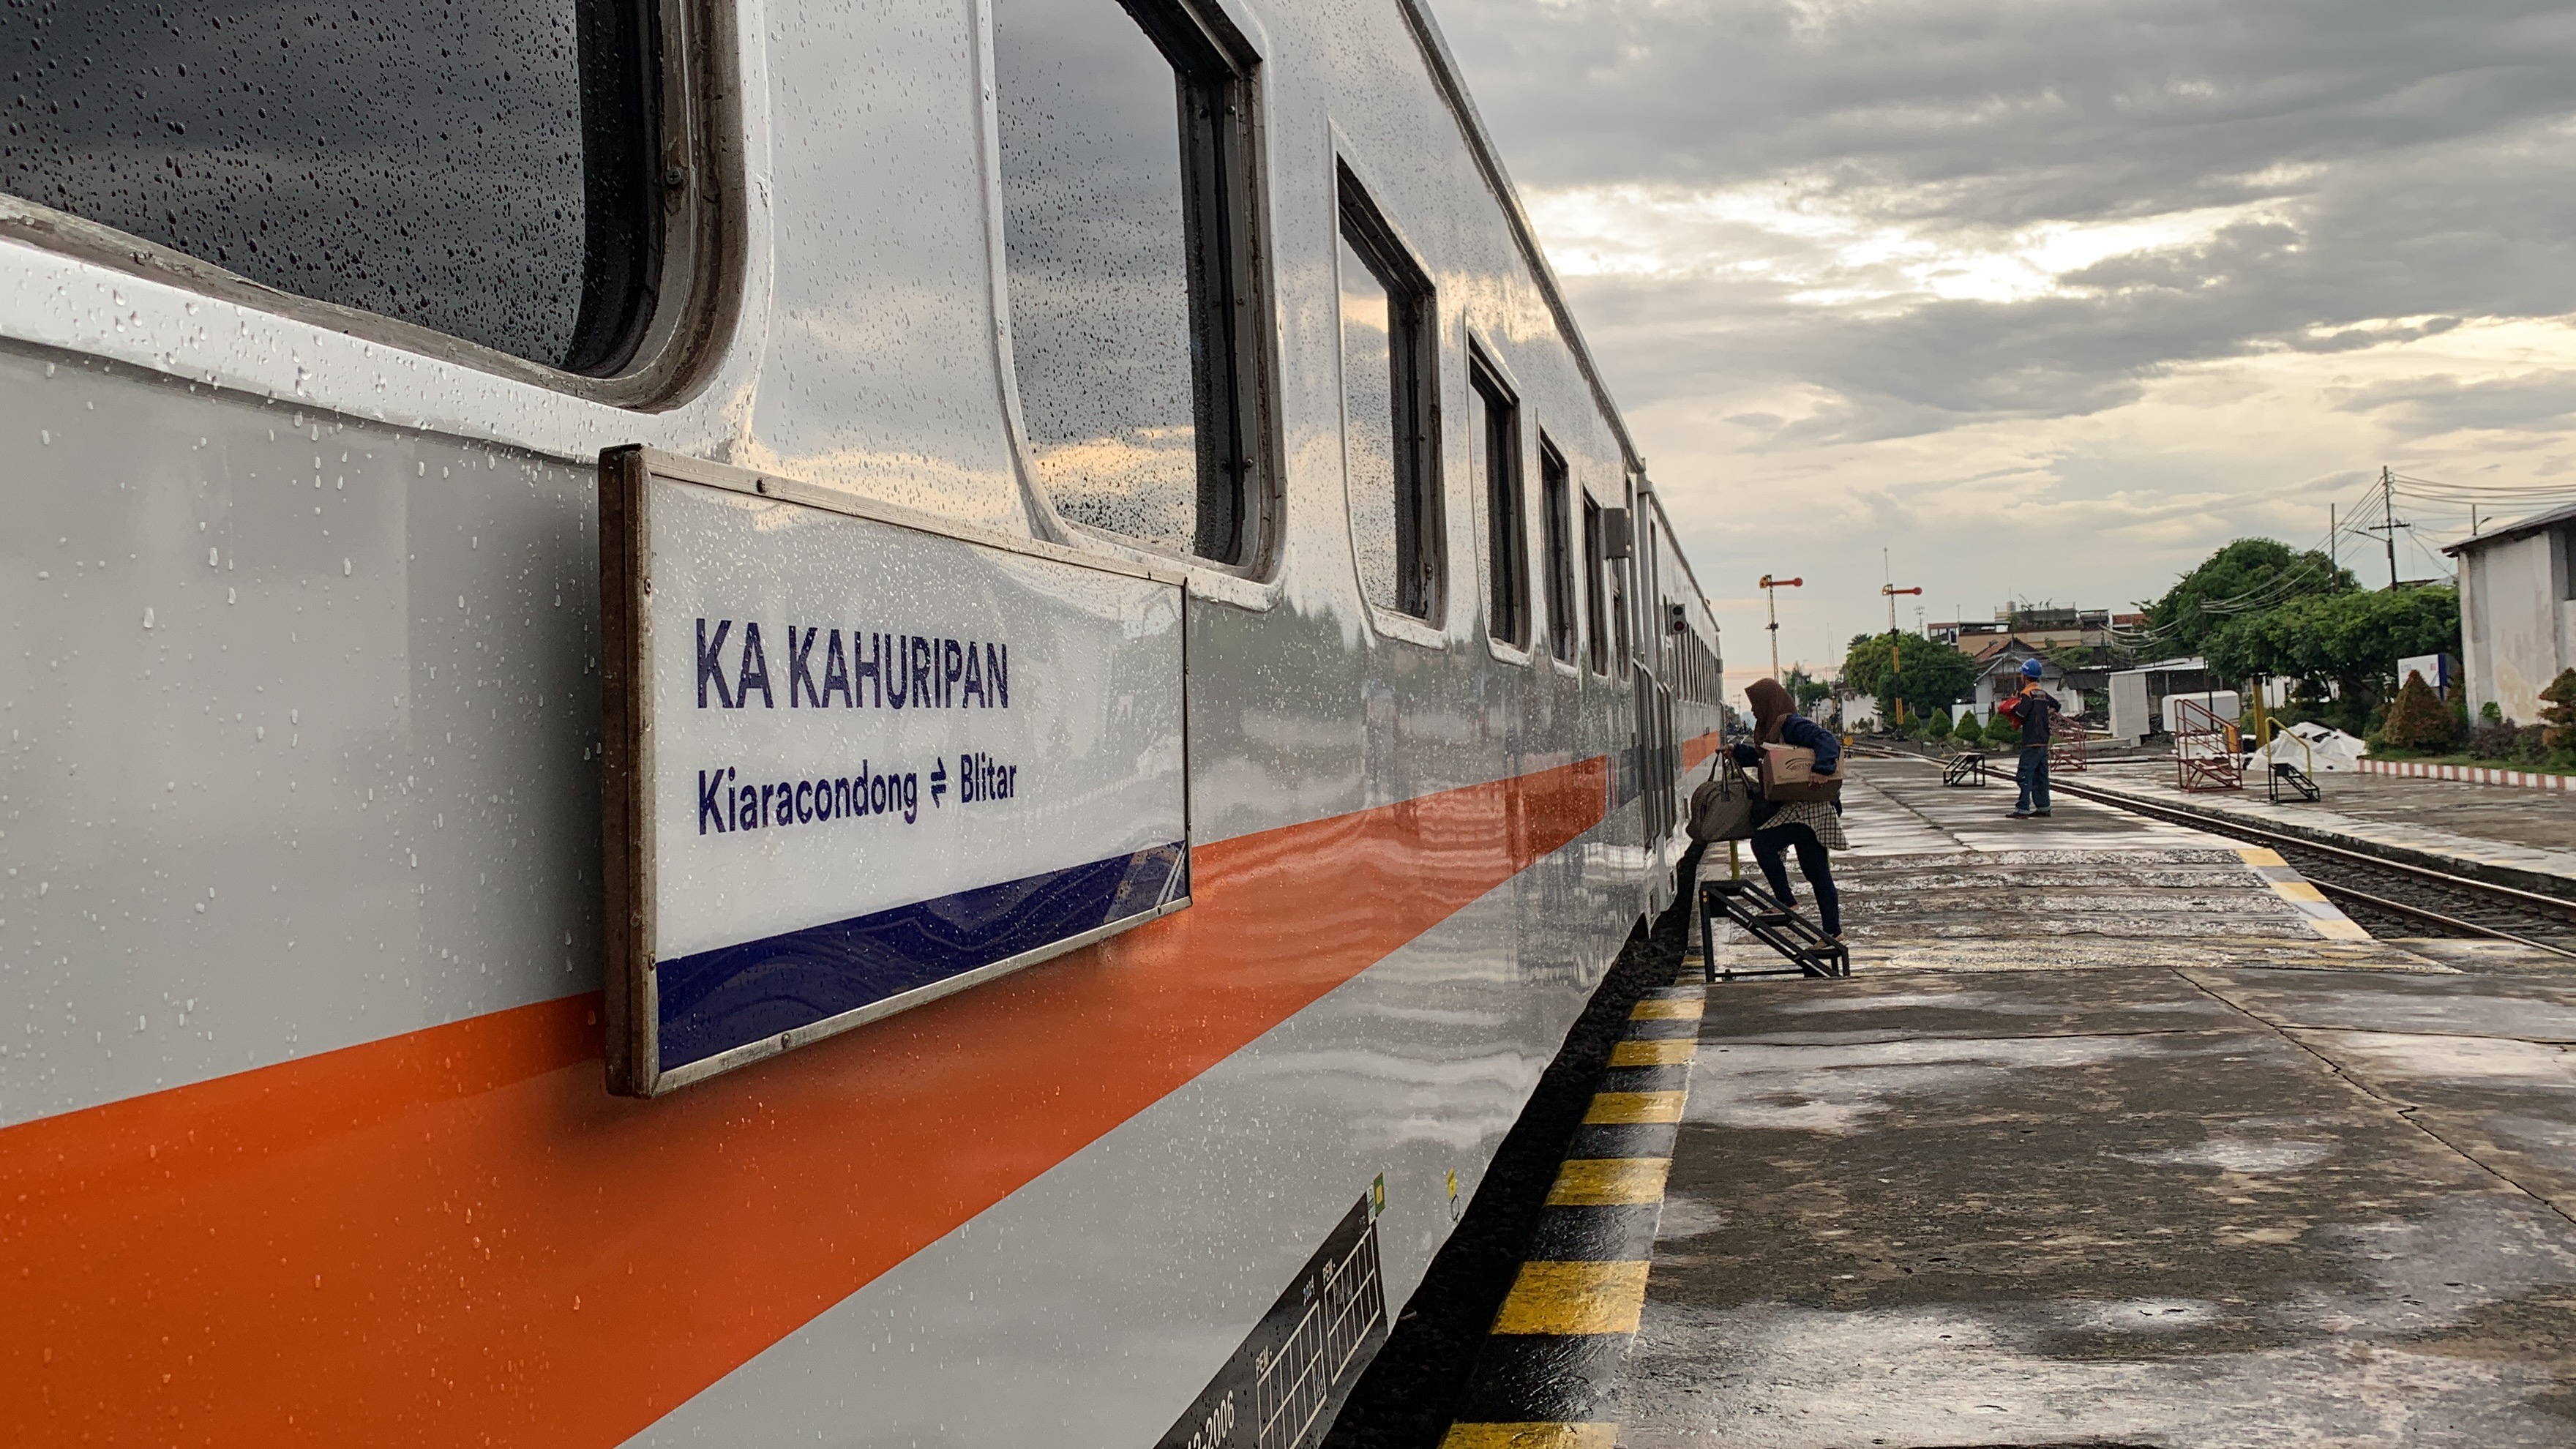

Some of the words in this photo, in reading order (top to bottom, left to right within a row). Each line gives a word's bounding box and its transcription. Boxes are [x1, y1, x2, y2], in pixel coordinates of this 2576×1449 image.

[696, 618, 775, 709] KA
[788, 625, 1008, 710] KAHURIPAN
[698, 759, 917, 836] Kiaracondong
[960, 752, 1017, 804] Blitar
